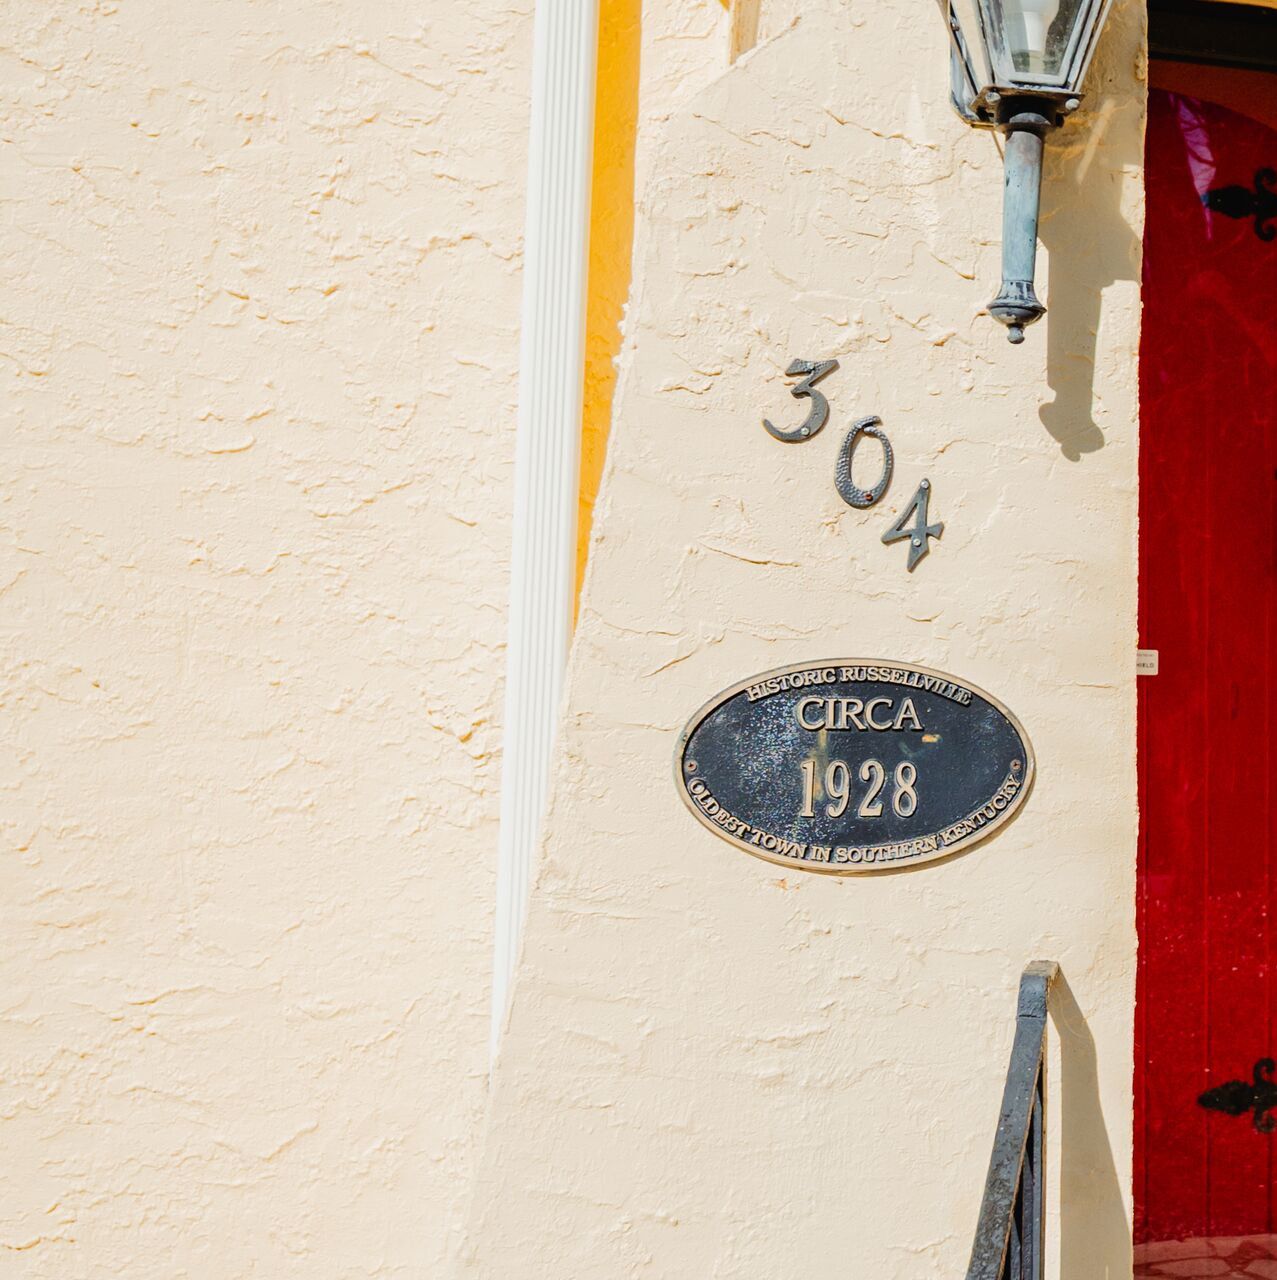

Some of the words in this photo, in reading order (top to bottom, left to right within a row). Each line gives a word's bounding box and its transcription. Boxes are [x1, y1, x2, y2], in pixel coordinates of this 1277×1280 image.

[763, 358, 945, 574] 304
[747, 669, 836, 701] HISTORIC
[841, 666, 972, 705] RUSSELLVILLE
[798, 696, 923, 731] CIRCA
[801, 760, 919, 818] 1928
[689, 778, 750, 838] OLDEST
[751, 829, 806, 859] TOWN
[810, 846, 832, 861] IN
[836, 835, 938, 863] SOUTHERN
[940, 774, 1021, 845] KENTUCKY
